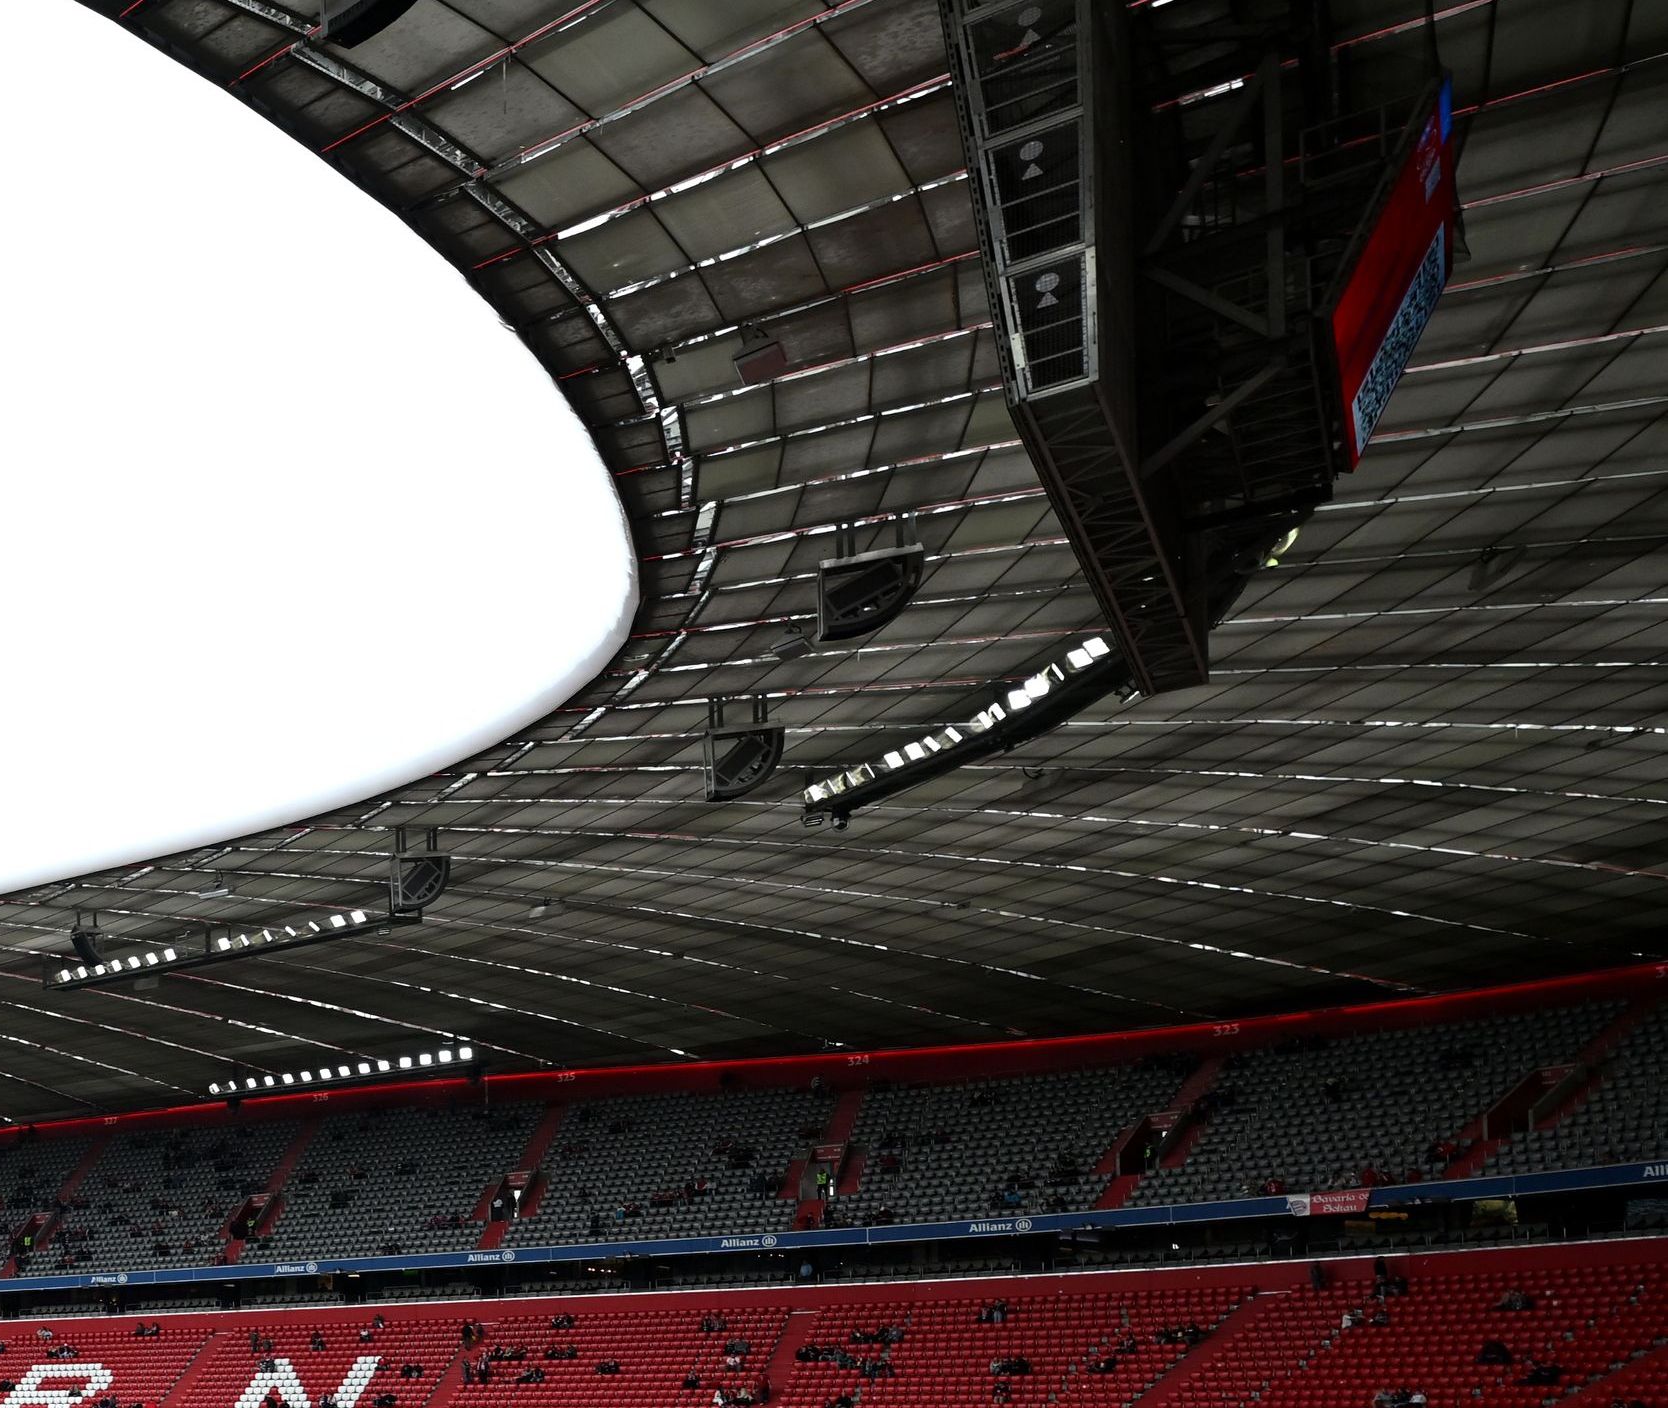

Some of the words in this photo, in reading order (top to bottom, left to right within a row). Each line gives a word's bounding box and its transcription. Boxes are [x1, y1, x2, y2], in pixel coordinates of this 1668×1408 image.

[969, 1222, 1013, 1233] Allianz
[720, 1237, 759, 1248] Allianz
[467, 1252, 500, 1262] Allianz
[275, 1264, 304, 1273] Allianz
